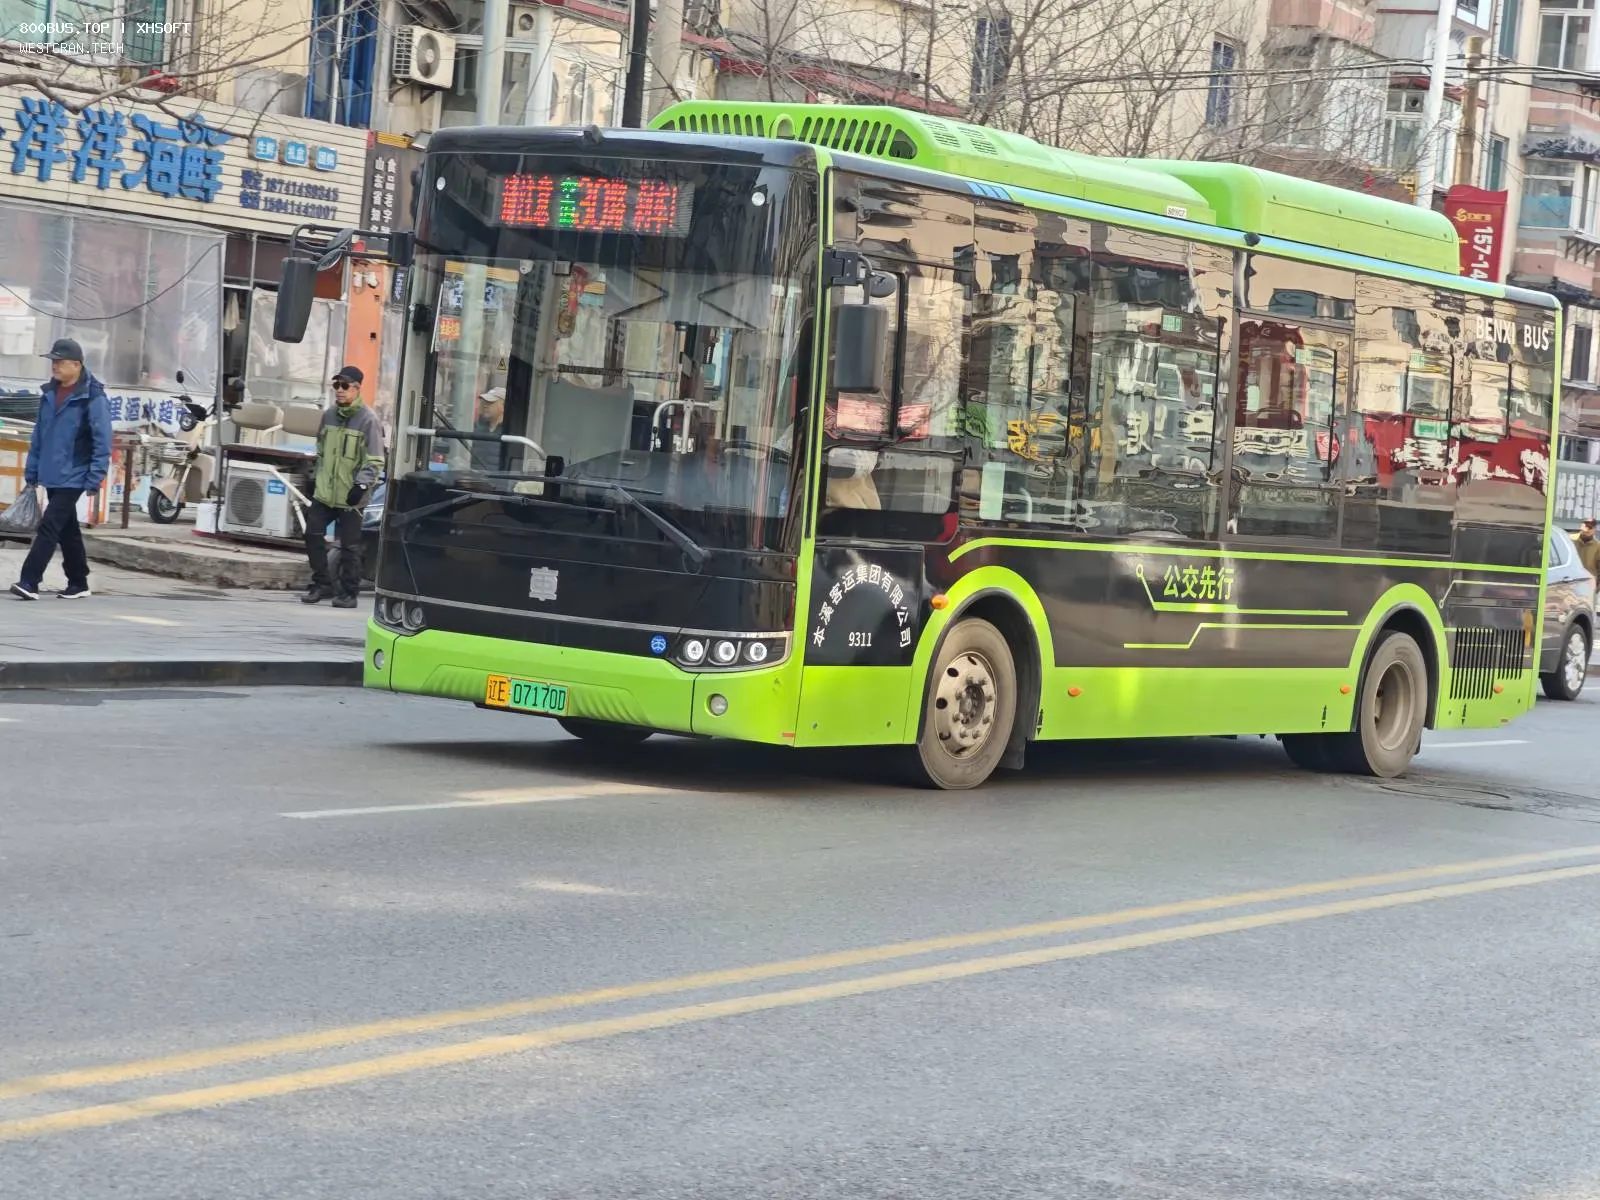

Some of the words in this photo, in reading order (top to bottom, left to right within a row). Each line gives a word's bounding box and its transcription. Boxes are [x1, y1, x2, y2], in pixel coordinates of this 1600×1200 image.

[0, 95, 231, 203] 洋洋海鲜
[1476, 316, 1517, 345] BENXI
[1523, 324, 1550, 351] BUS
[1163, 564, 1235, 601] 公交先行
[813, 564, 912, 648] 本溪客运集团有限公司
[848, 631, 872, 648] 9311
